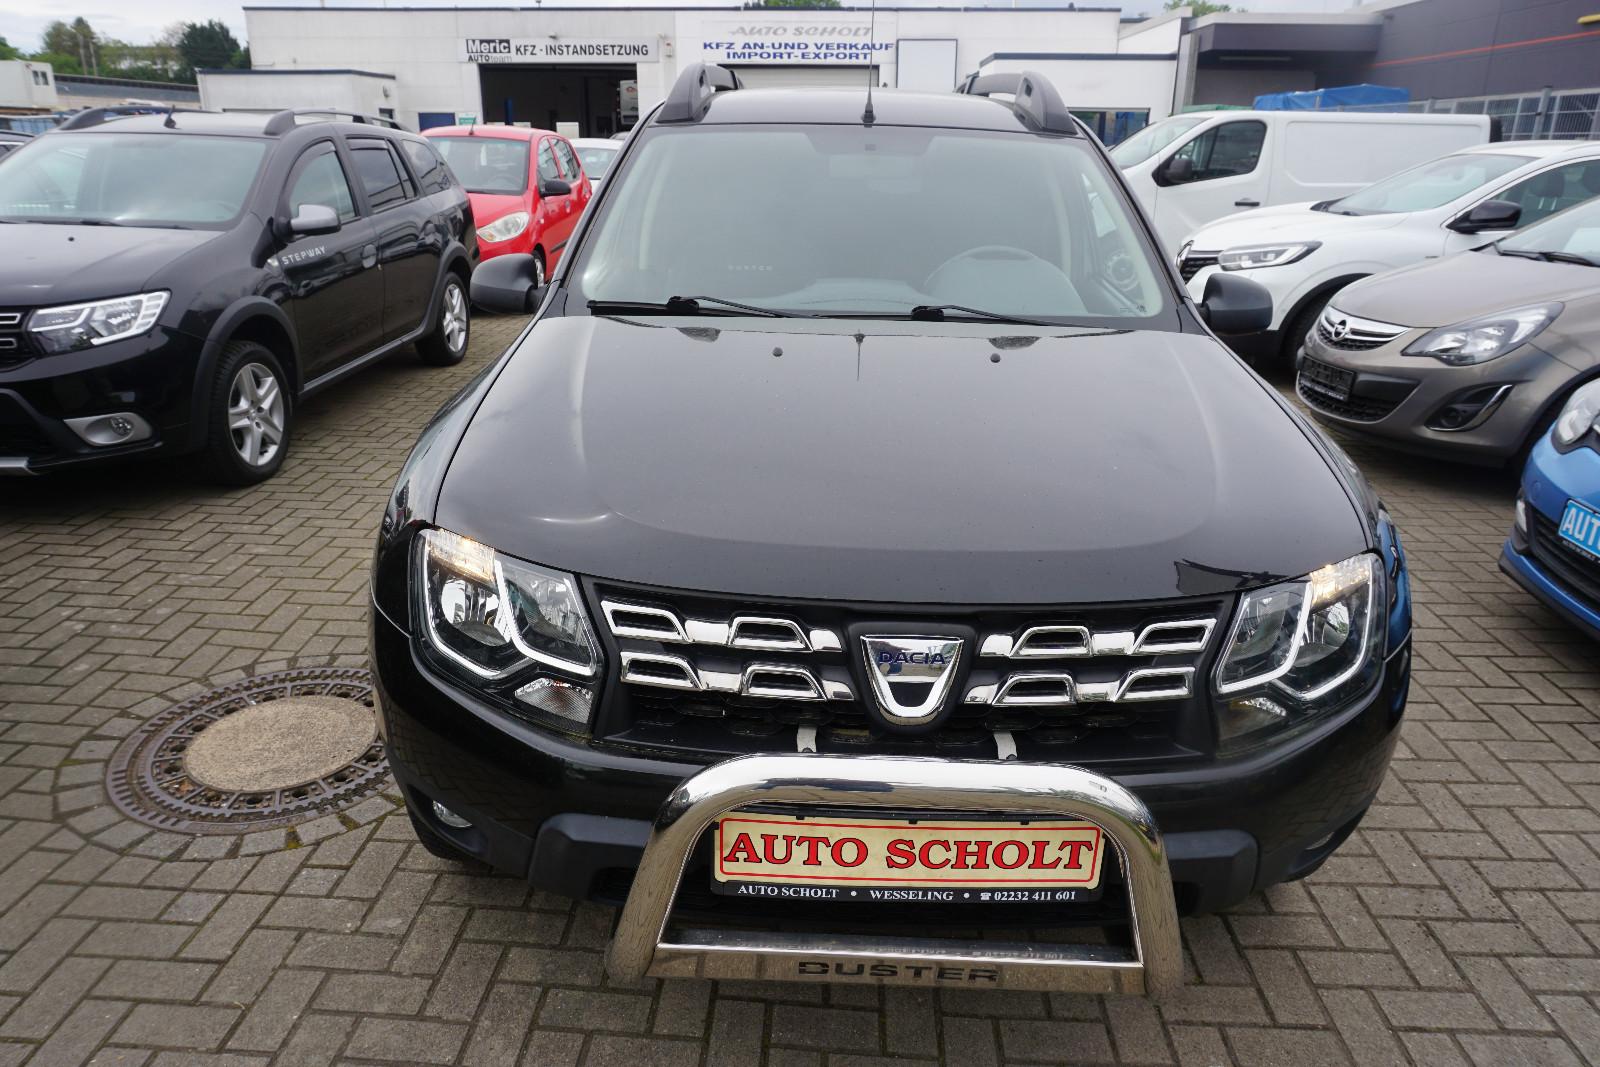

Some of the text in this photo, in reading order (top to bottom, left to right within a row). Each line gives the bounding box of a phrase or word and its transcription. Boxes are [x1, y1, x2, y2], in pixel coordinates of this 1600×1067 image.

[729, 26, 873, 37] AUTO SCHOLT
[467, 40, 511, 54] Meric
[515, 44, 537, 56] KFZ
[545, 44, 649, 56] INSTANDSETZUNG
[703, 42, 894, 51] KFZ AN-UND VERKAUF
[726, 51, 871, 60] IMPORT-EXPORT
[281, 246, 326, 265] STEPWAY
[1562, 507, 1600, 551] AUT
[879, 651, 946, 665] DACIA
[723, 832, 1094, 870] AUTO SCHOLT
[738, 885, 1077, 902] AUTO SCHOLT WESSELING 02232 411 601
[798, 961, 1000, 983] DUSTER
